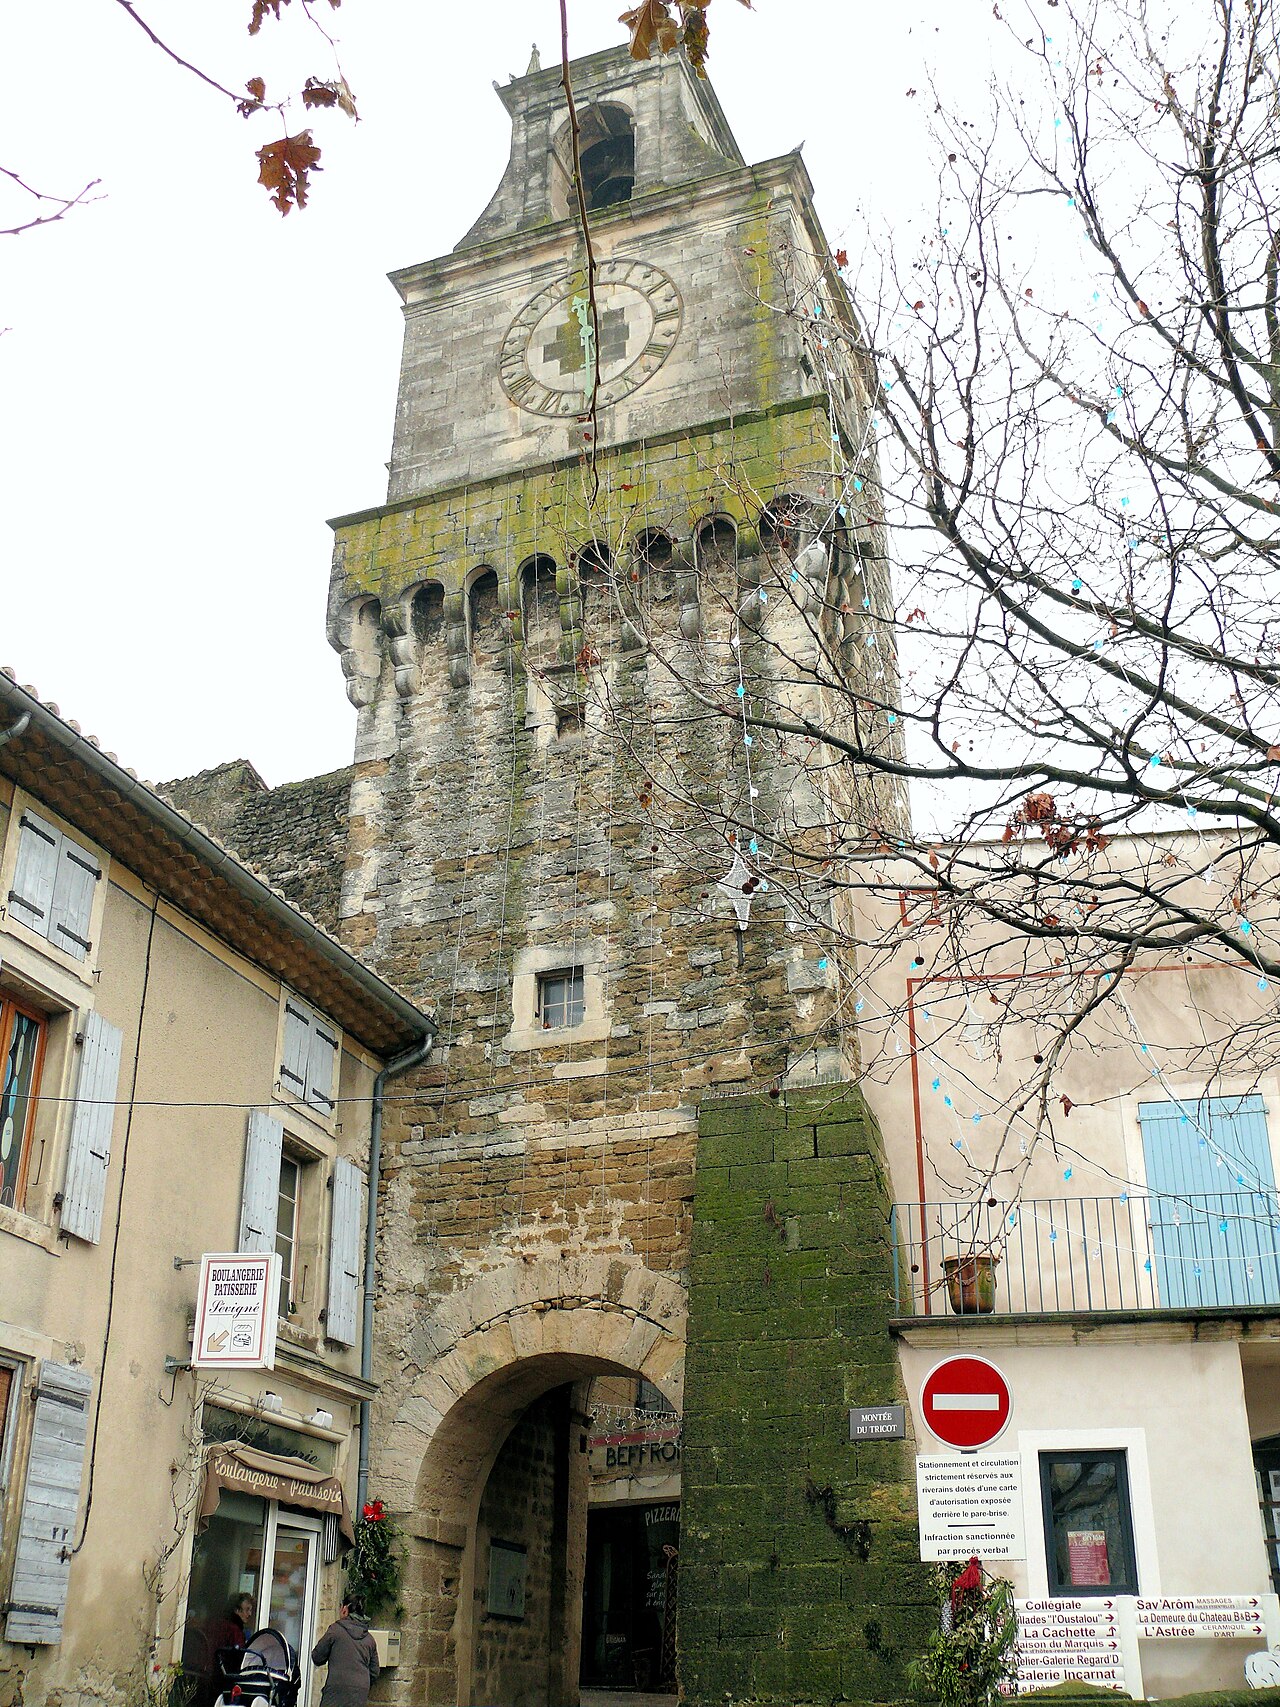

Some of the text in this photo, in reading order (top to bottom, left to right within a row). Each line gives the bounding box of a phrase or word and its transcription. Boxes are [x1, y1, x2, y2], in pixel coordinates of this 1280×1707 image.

[212, 1268, 264, 1281] BOULANGERIE
[214, 1283, 257, 1296] PATISSERIE
[209, 1300, 259, 1319] Sévigné
[861, 1411, 892, 1422] MONTÉE
[857, 1424, 897, 1434] DU TRICOT
[919, 1461, 970, 1469] Stationnement
[981, 1459, 1019, 1467] circulation
[925, 1473, 965, 1481] strictement
[967, 1472, 998, 1480] réservés
[955, 1485, 975, 1493] dotés
[977, 1484, 997, 1492] d'une
[929, 1496, 1011, 1506] d'autorisation exposée
[932, 1510, 960, 1518] derrière
[971, 1510, 1009, 1519] pare-brise.
[924, 1532, 1015, 1541] Infraction sanctionnée
[938, 1548, 950, 1556] par
[983, 1546, 1009, 1554] verbal
[1025, 1600, 1081, 1612] Collégiale
[1136, 1599, 1194, 1610] Sav'Arôm
[1139, 1613, 1149, 1623] La
[1151, 1613, 1185, 1623] Demeure
[1188, 1612, 1198, 1622] du
[1200, 1611, 1232, 1622] Chateau
[1024, 1627, 1096, 1638] La Cachette
[1144, 1625, 1195, 1637] L'Astrée
[1049, 1640, 1061, 1648] du
[1064, 1639, 1104, 1650] Marquis
[1077, 1654, 1119, 1667] Regard'D
[1017, 1669, 1116, 1681] Galerie Incarnat
